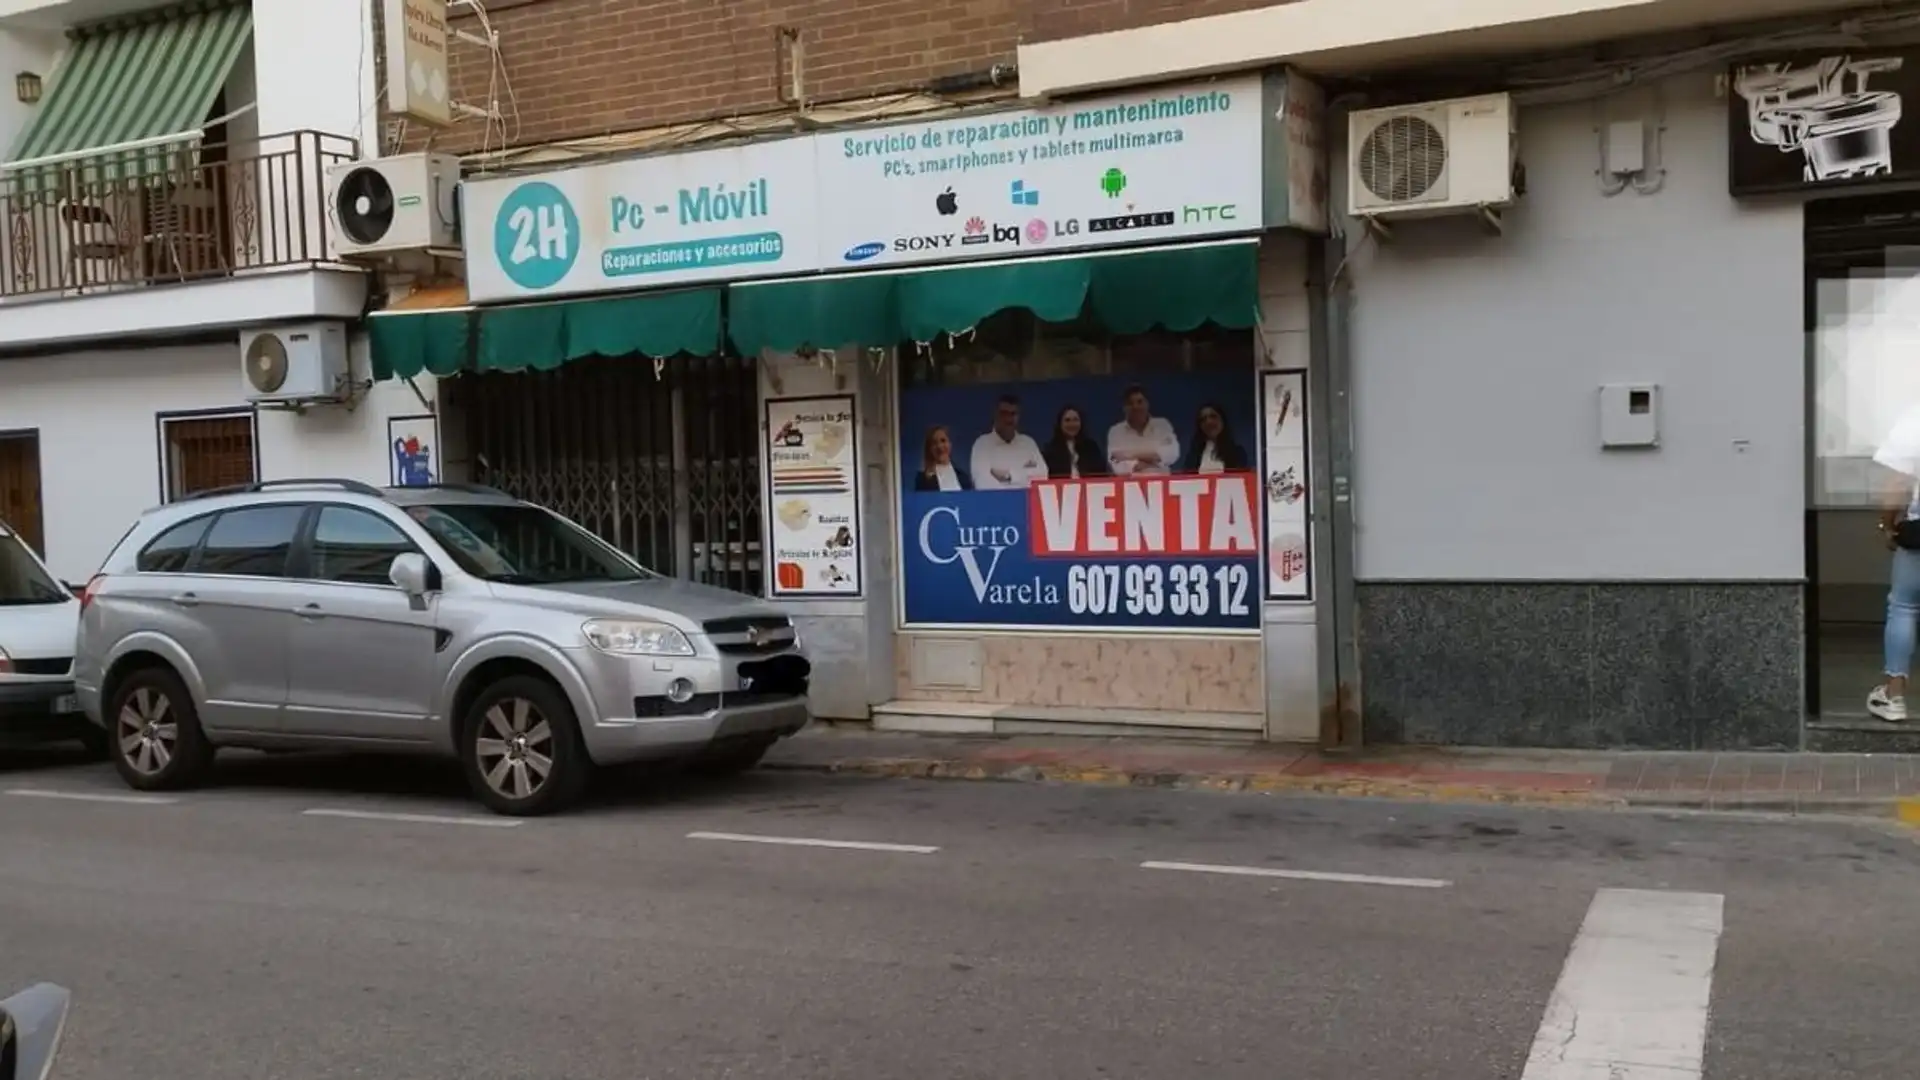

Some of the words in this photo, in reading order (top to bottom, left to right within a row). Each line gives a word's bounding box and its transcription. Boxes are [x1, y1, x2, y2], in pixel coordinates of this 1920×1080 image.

[844, 133, 916, 158] Servicio
[922, 128, 942, 148] de
[1056, 116, 1067, 134] y
[1073, 91, 1230, 129] mantenimiento
[919, 147, 1014, 172] smartphones
[1018, 147, 1028, 164] y
[1033, 141, 1085, 160] tablets
[1089, 128, 1183, 154] multimarca
[609, 196, 645, 232] Pc
[678, 178, 769, 225] Móvil
[1054, 219, 1080, 237] LG
[1092, 213, 1169, 231] ALCATEL
[508, 204, 568, 264] 2H
[603, 248, 692, 270] Reparaciones
[695, 247, 704, 263] y
[707, 237, 781, 260] accesorios
[894, 234, 956, 252] SONY
[993, 223, 1020, 246] bq
[918, 506, 1020, 564] Curro
[1038, 477, 1257, 552] VENTA
[955, 546, 1060, 604] Varela
[1068, 565, 1120, 615] 607
[1125, 565, 1163, 614] 93
[1169, 564, 1208, 615] 33
[1214, 564, 1249, 614] 12
